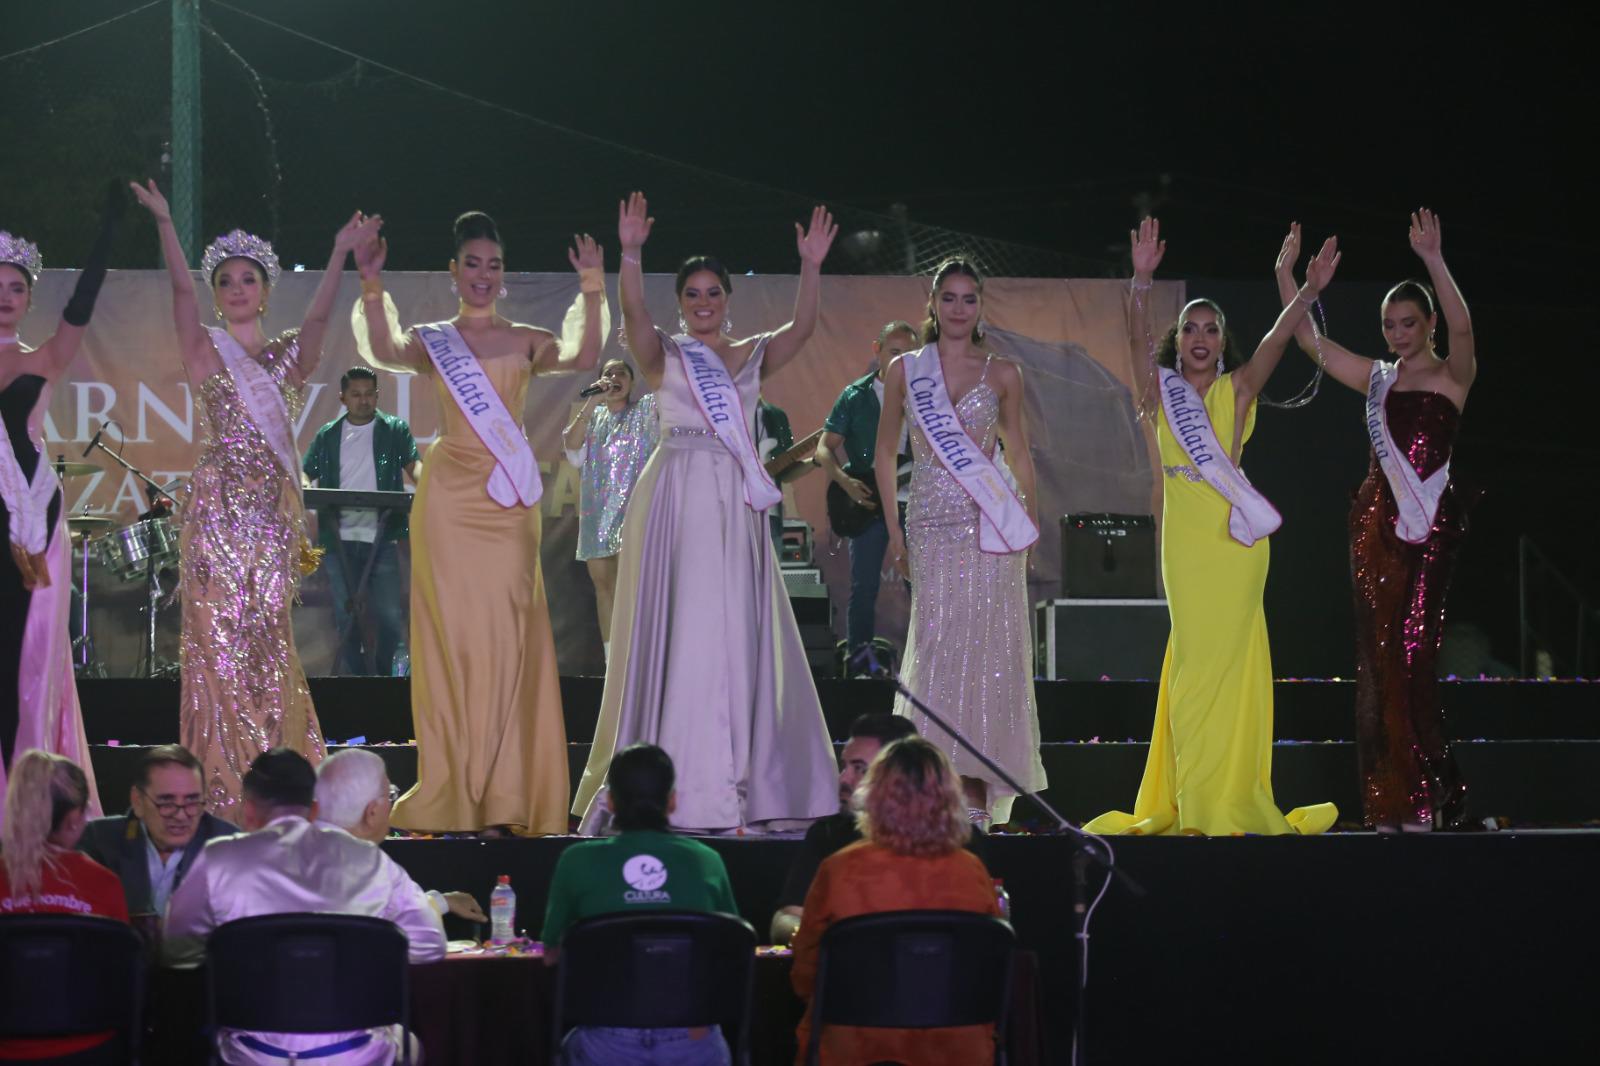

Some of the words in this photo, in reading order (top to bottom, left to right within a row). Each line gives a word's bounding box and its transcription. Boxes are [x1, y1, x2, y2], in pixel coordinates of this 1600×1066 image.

[422, 328, 491, 416] Candidata
[910, 376, 974, 472] Candidata
[1164, 374, 1214, 466] Candidata
